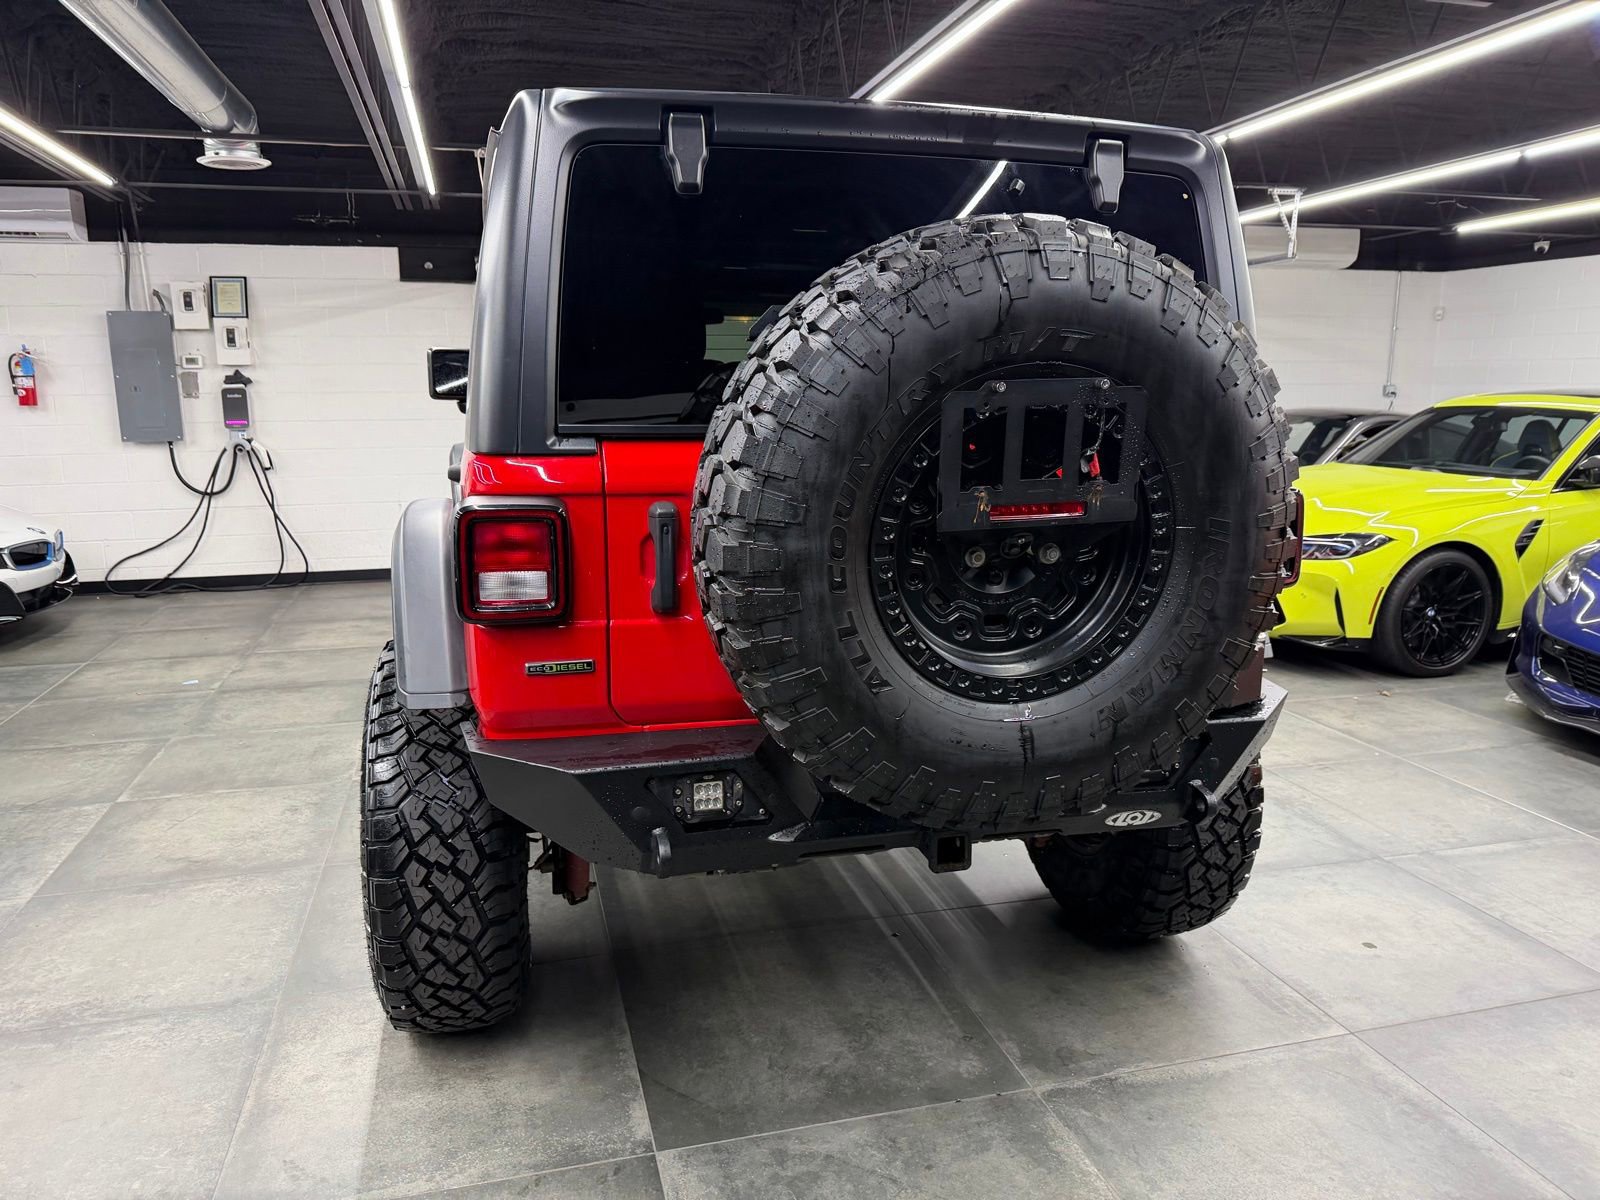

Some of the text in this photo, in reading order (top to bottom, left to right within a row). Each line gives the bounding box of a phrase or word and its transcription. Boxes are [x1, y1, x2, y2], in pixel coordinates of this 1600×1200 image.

[827, 351, 962, 594] COUNTRY
[835, 610, 896, 695] ALL
[1096, 516, 1232, 732] IRONMAN
